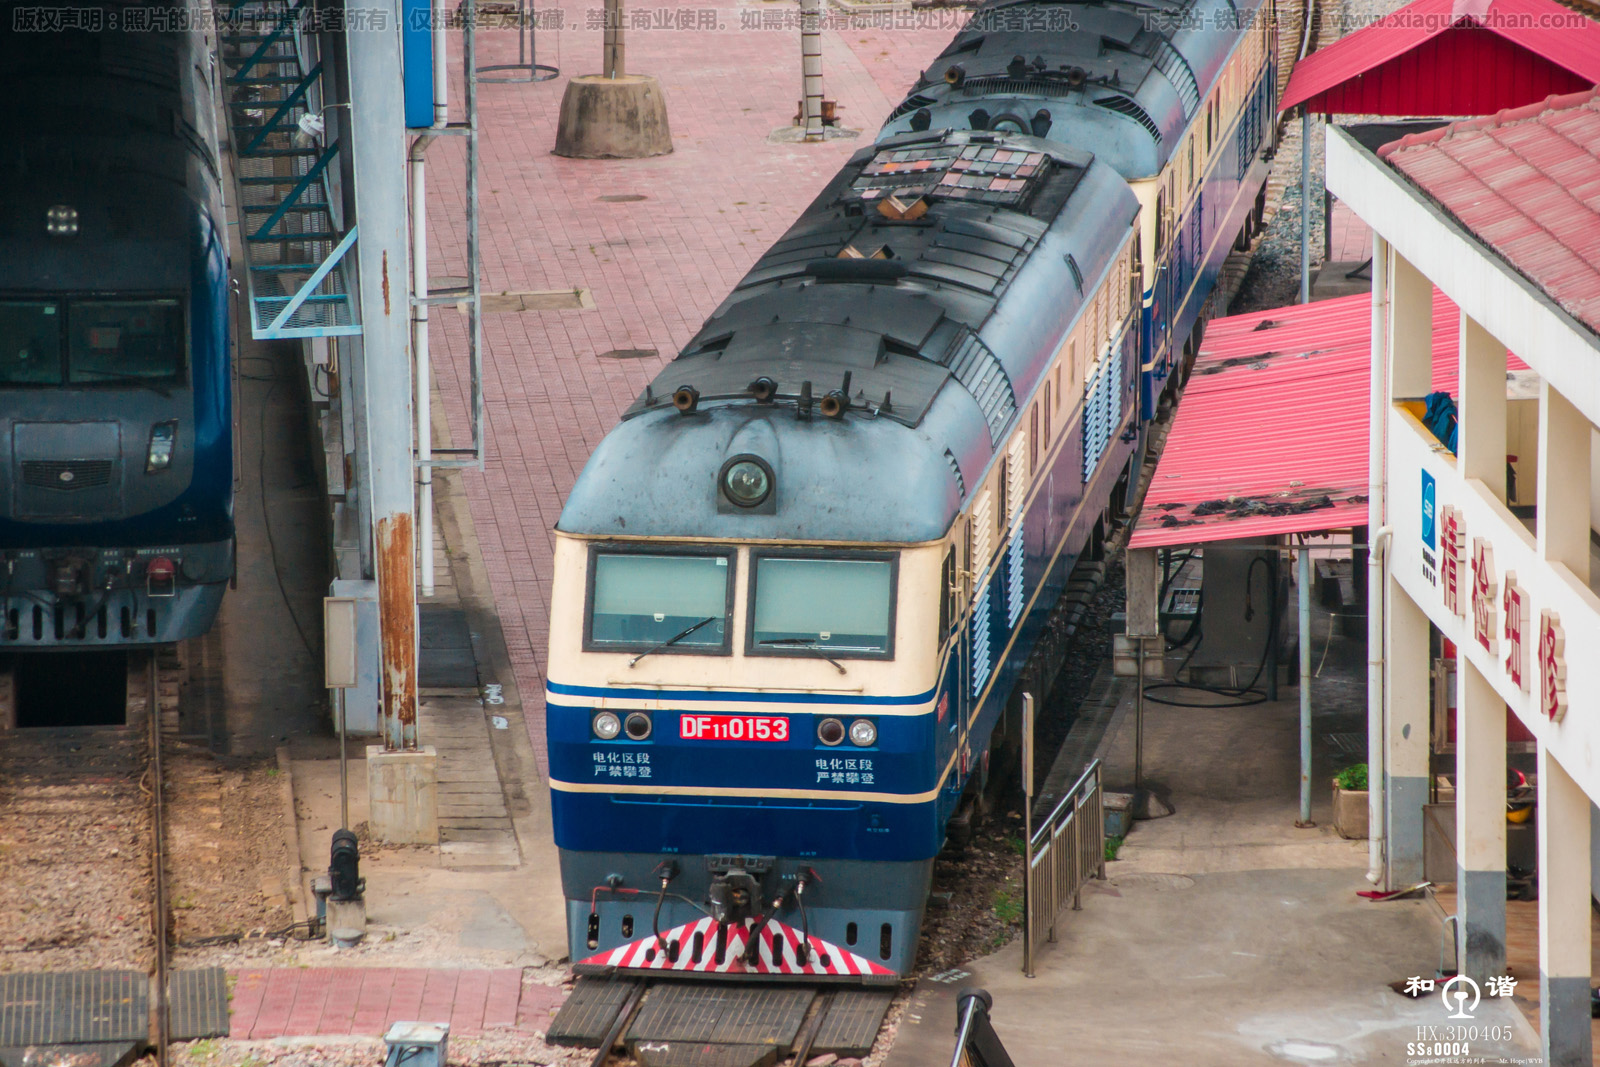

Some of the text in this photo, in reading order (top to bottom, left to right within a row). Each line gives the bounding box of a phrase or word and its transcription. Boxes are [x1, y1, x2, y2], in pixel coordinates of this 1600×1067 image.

[1440, 505, 1568, 722] 精检细修
[592, 752, 650, 764] 电化区段
[815, 758, 874, 770] 电化区段
[594, 765, 652, 778] 严禁攀登
[816, 772, 875, 784] 严禁攀登
